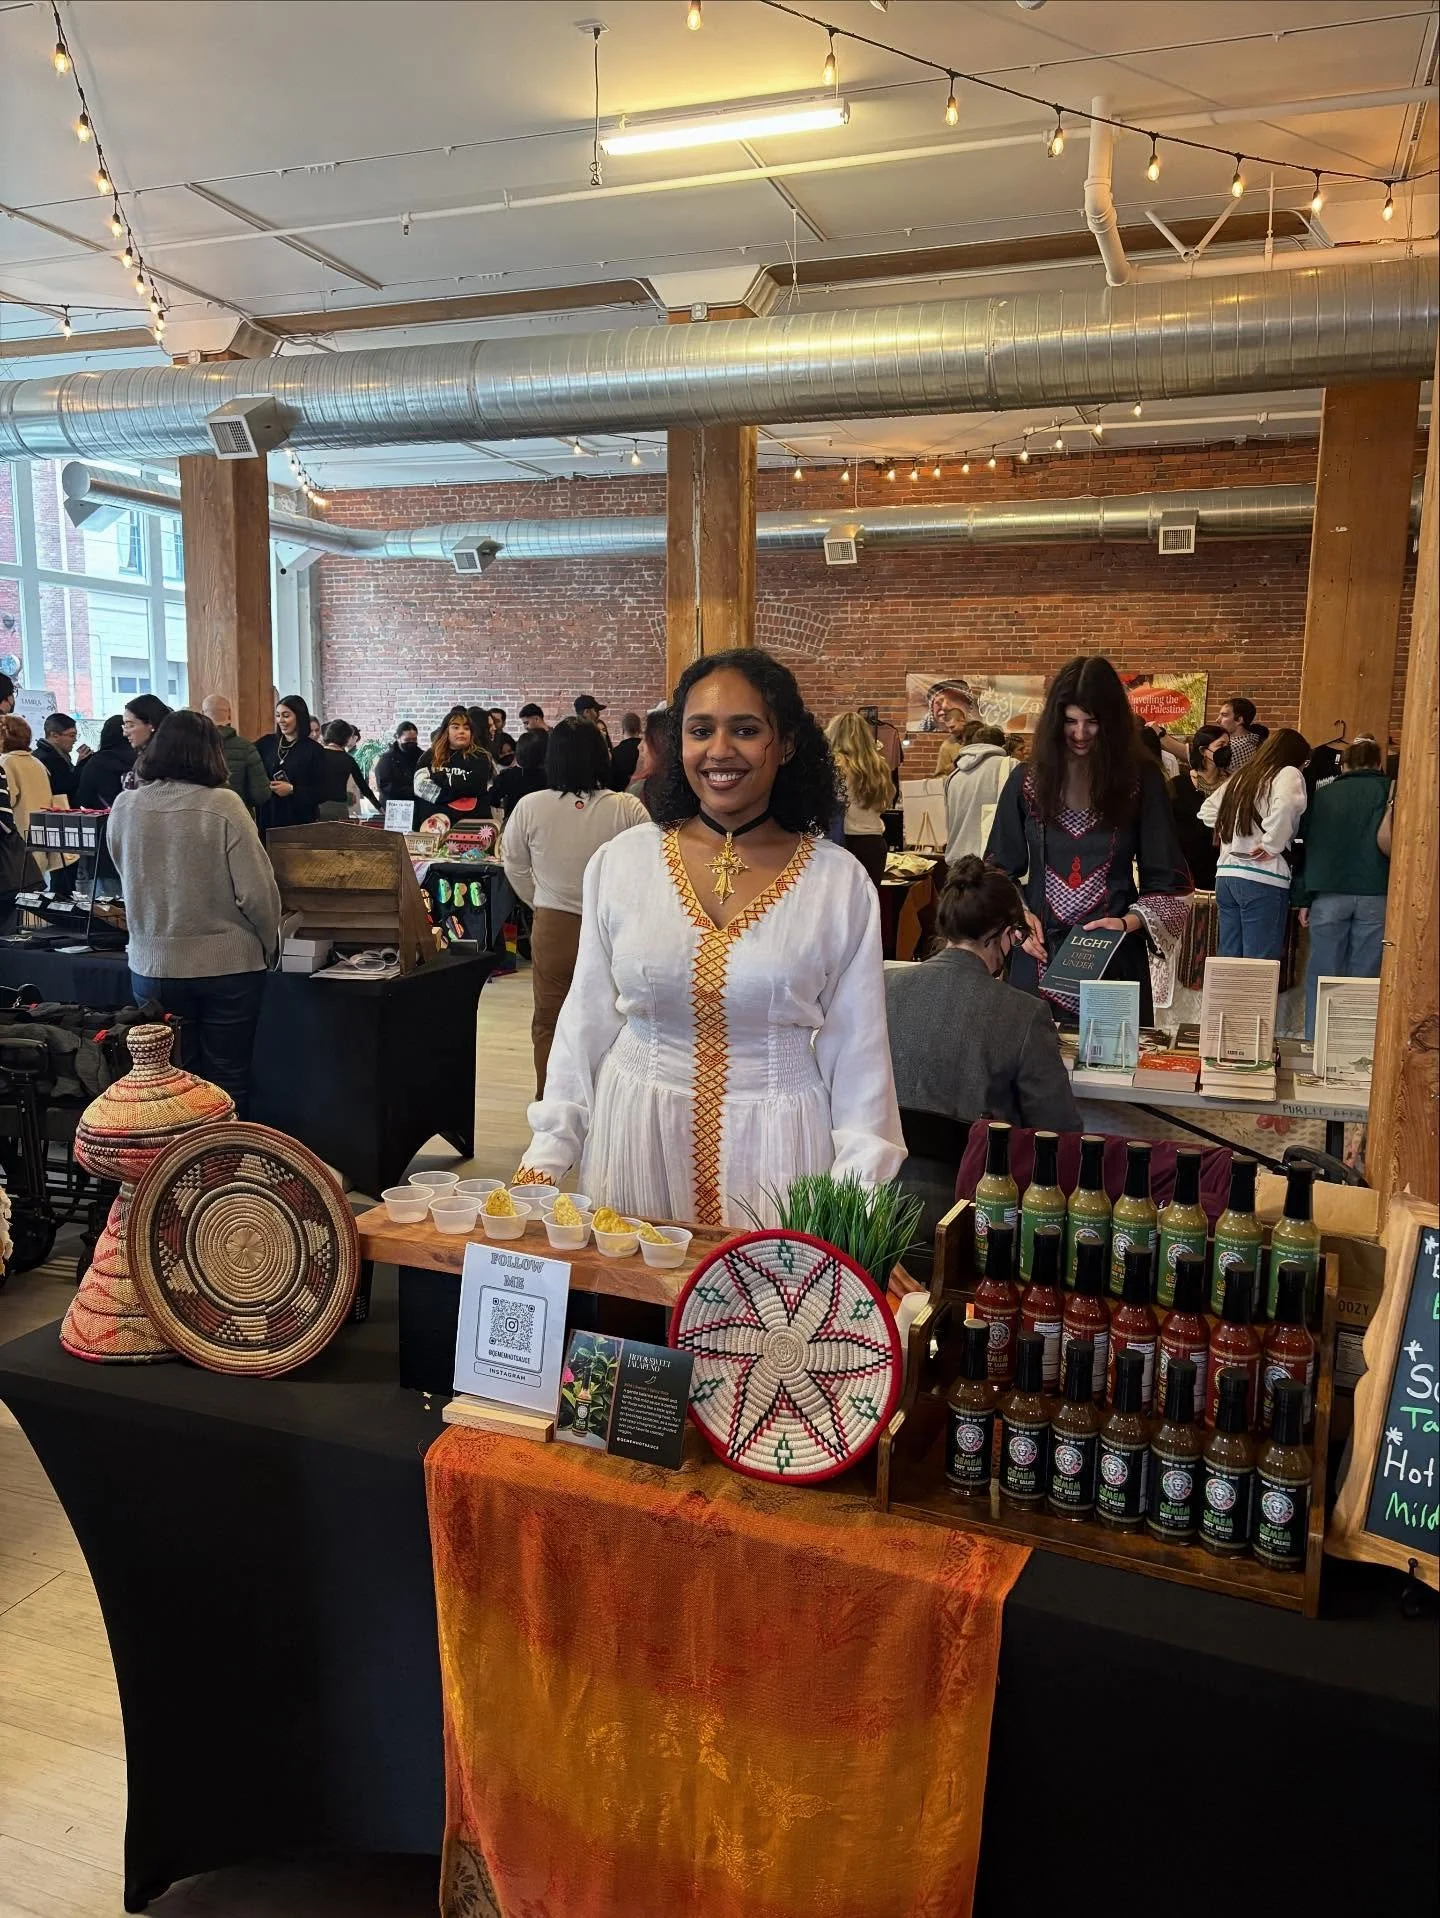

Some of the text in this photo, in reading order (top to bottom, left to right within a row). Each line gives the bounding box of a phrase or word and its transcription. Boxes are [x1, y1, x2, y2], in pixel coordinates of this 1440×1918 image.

[1166, 694, 1179, 705] the
[1141, 703, 1149, 714] of
[1150, 703, 1187, 714] Palestine.
[1070, 935, 1113, 950] LIGHT
[1062, 958, 1095, 970] UNDER
[490, 1252, 545, 1274] FOLLOW
[503, 1274, 525, 1290] ME
[489, 1368, 526, 1381] INSTAGRAM
[1406, 1362, 1440, 1402] S
[1384, 1444, 1435, 1487] Hot
[1053, 1484, 1062, 1492] HOT
[1099, 1493, 1108, 1502] HOT
[1160, 1511, 1172, 1519] HOT
[1385, 1491, 1440, 1530] Mild
[1203, 1519, 1214, 1528] HOT
[1260, 1532, 1271, 1542] HOT
